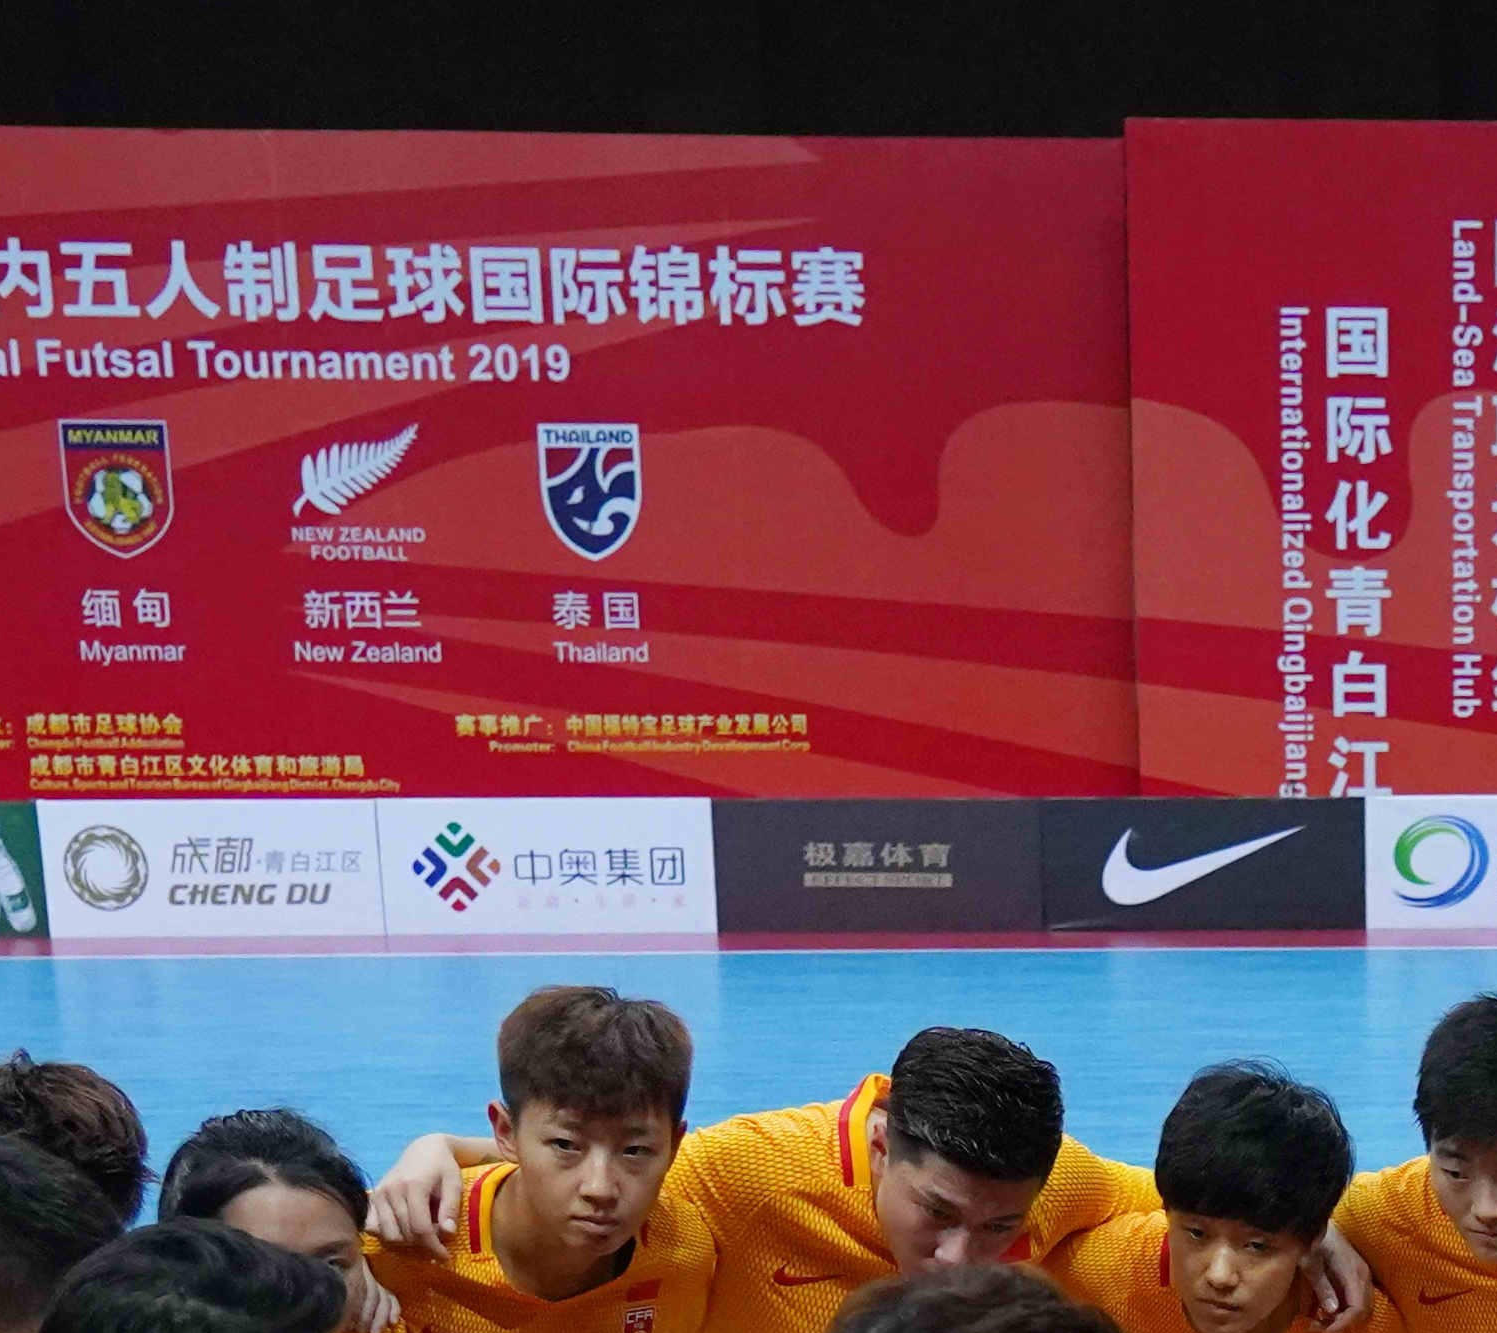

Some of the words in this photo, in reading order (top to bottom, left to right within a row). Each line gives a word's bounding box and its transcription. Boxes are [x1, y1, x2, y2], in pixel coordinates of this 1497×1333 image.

[1453, 219, 1484, 388] Land-Sea
[35, 338, 174, 379] Futsal
[187, 340, 456, 381] Tournament
[468, 343, 572, 383] 2019
[67, 430, 159, 445] MYANMAR
[544, 428, 633, 444] THAILAND
[1279, 306, 1313, 589] Internationalized
[291, 526, 335, 542] NEW
[338, 526, 426, 543] ZEALAND
[1446, 396, 1483, 645] Transportation
[311, 544, 408, 561] FOOTBALL
[1325, 306, 1393, 797] 国际化青白江
[81, 588, 171, 629] 缅甸
[303, 589, 422, 630] 新西兰
[552, 590, 640, 630] 泰国
[79, 640, 186, 667] Myanmar
[293, 640, 346, 663] New
[351, 640, 443, 663] Zealand
[553, 641, 650, 663] Thailand
[1277, 597, 1315, 798] Qingbaijiang
[1453, 653, 1482, 718] Hub
[25, 712, 184, 736] 成都市足球协会
[29, 755, 365, 778] 成都市青白江区文化体育和旅游局
[513, 846, 686, 887] 中奥集团
[167, 882, 278, 906] CHENG
[285, 882, 332, 906] DU
[626, 1310, 654, 1324] CFA
